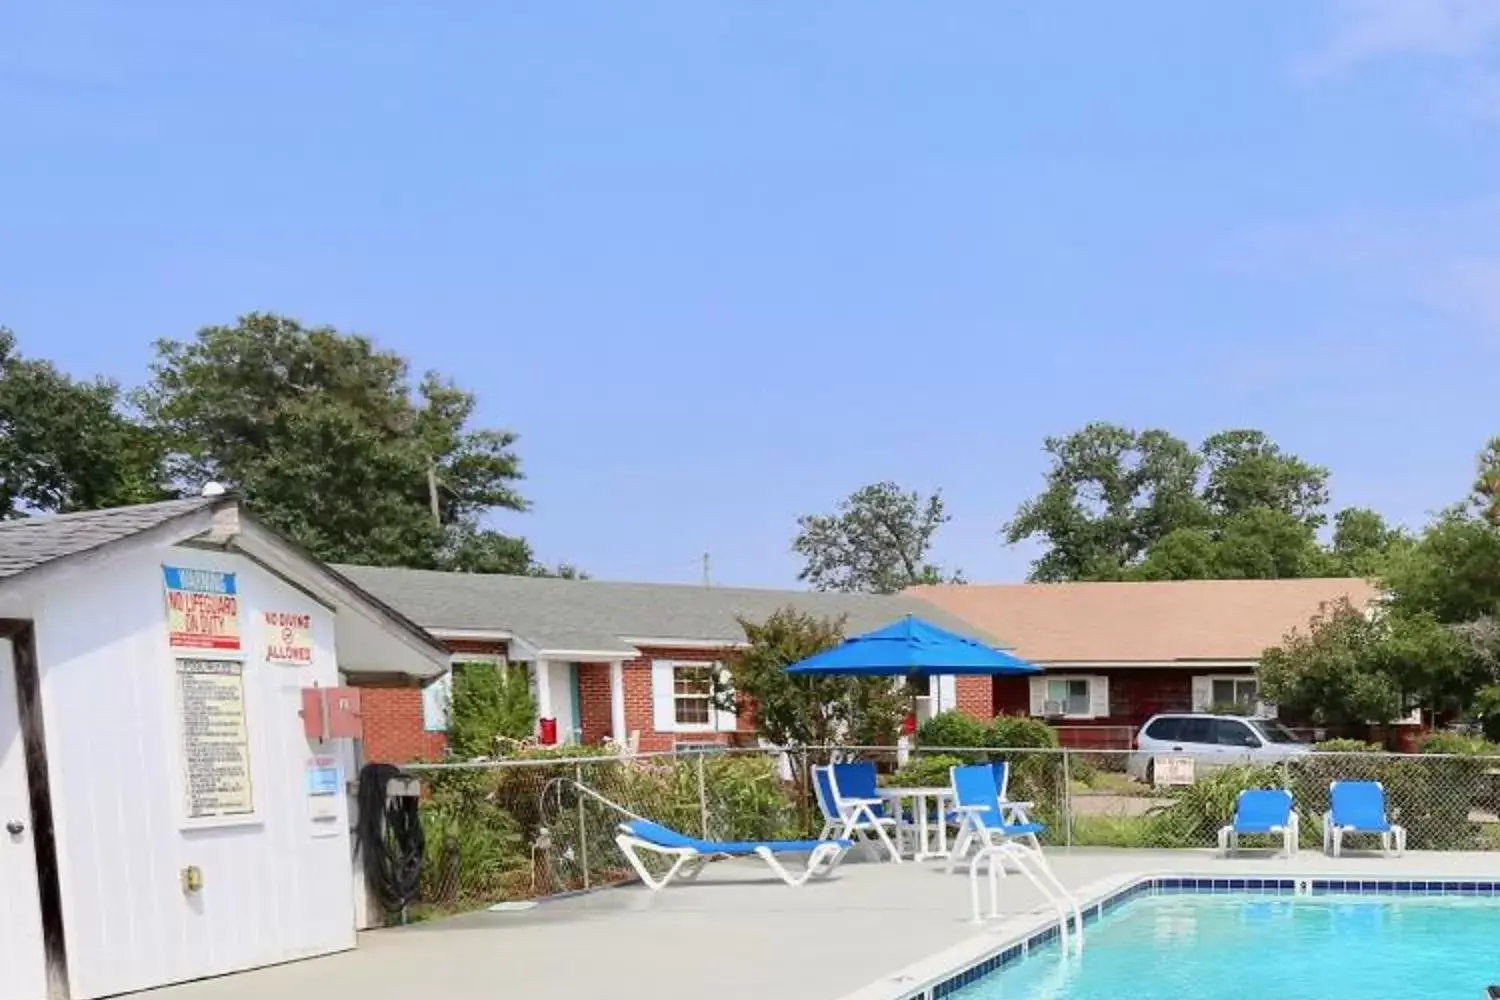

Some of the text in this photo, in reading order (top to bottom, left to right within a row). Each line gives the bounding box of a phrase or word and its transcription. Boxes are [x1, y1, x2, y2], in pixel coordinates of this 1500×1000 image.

[180, 567, 227, 592] WARNING
[167, 591, 237, 616] NO LIFEGUARD
[186, 612, 225, 635] ON DUTY
[264, 611, 310, 629] NO DIVING
[267, 645, 310, 661] ALLOWED
